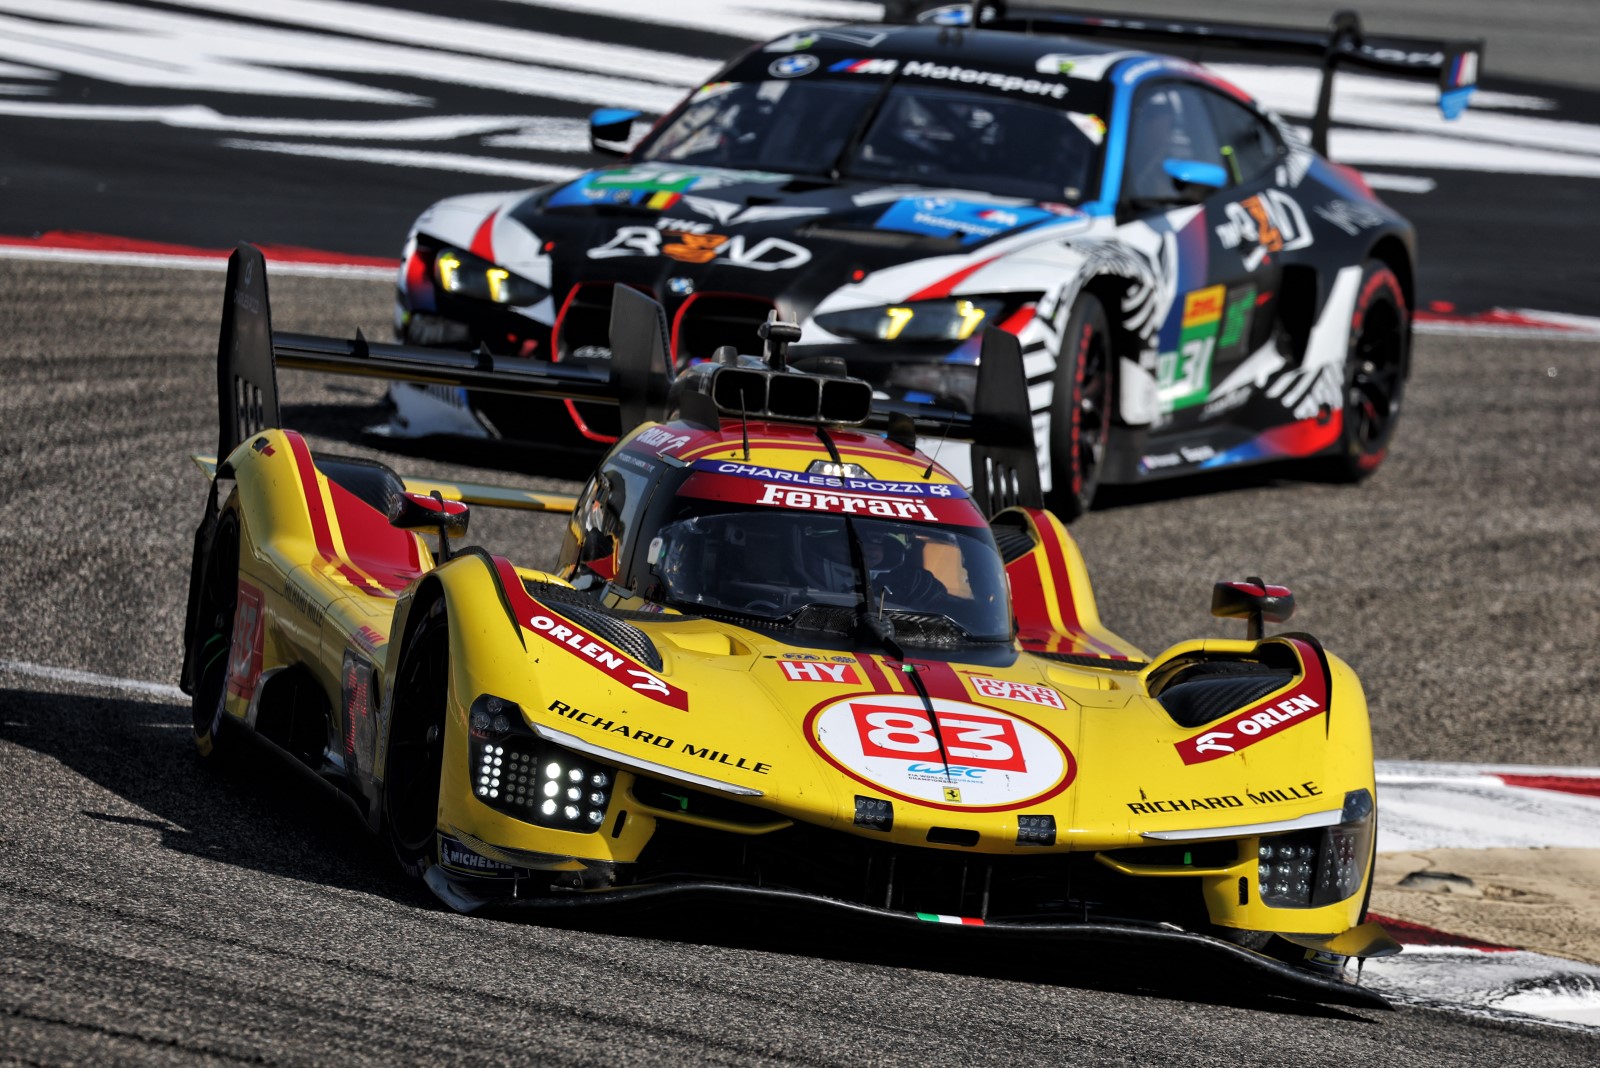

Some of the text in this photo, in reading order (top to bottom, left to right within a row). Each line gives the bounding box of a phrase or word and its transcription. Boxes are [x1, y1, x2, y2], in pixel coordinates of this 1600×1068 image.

[902, 60, 1070, 99] Motorsport
[656, 217, 713, 235] THE
[636, 427, 675, 448] ORLEN
[718, 463, 924, 494] CHARLES POZZI
[756, 484, 938, 521] Ferrari
[530, 615, 624, 670] ORLEN
[781, 661, 846, 682] HY
[976, 679, 1052, 696] HYPER
[981, 685, 1059, 706] CAR
[1237, 693, 1320, 736] ORLEN
[547, 700, 773, 775] RICHARD MILLE
[865, 711, 1014, 761] 83
[907, 763, 987, 779] WEC
[1126, 781, 1323, 815] RICHARD MILLE
